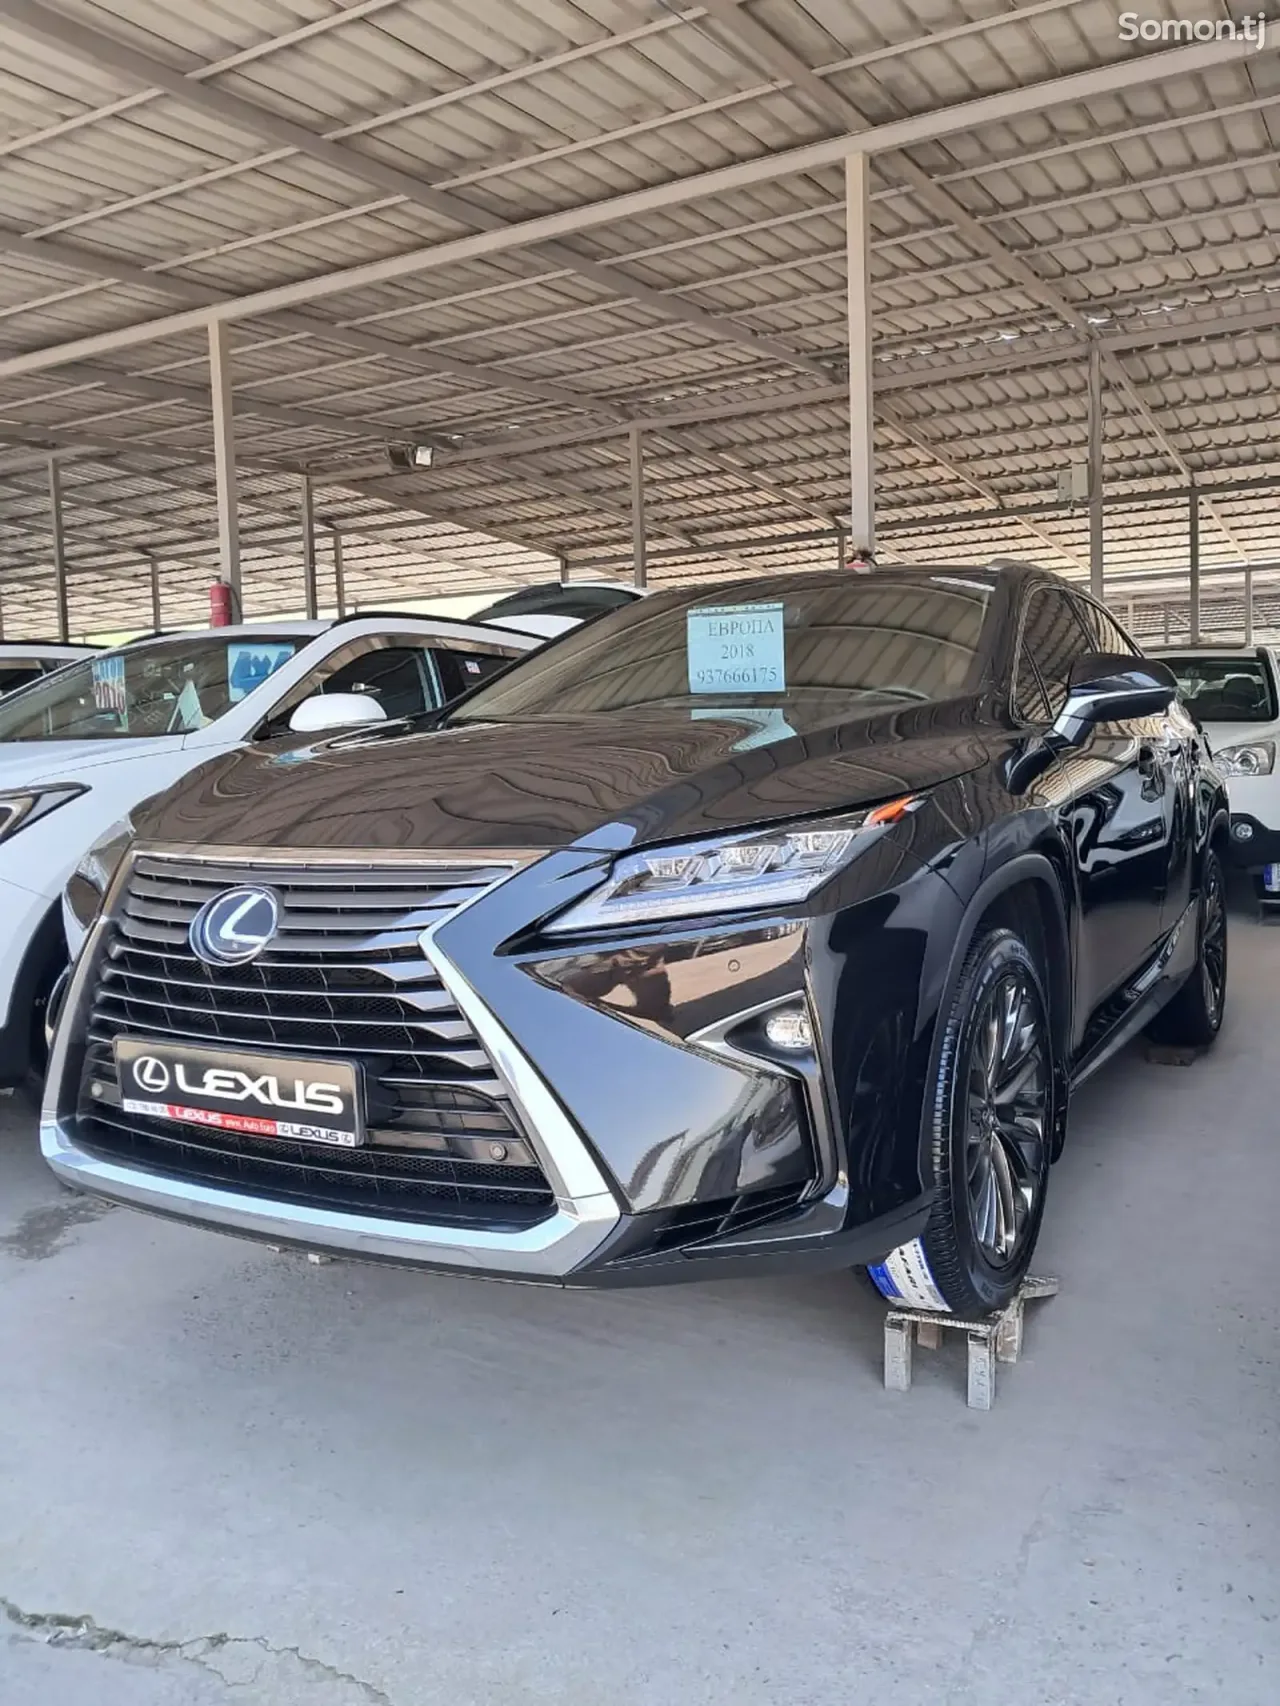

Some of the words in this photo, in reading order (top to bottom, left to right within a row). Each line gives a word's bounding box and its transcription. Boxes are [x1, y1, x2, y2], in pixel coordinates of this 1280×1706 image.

[708, 619, 775, 637] ЕВРОПА
[720, 643, 755, 660] 2018
[697, 666, 778, 685] 937666175
[174, 1063, 344, 1115] LEXUS
[175, 1107, 222, 1126] LEXUS
[290, 1125, 339, 1142] LEXUS
